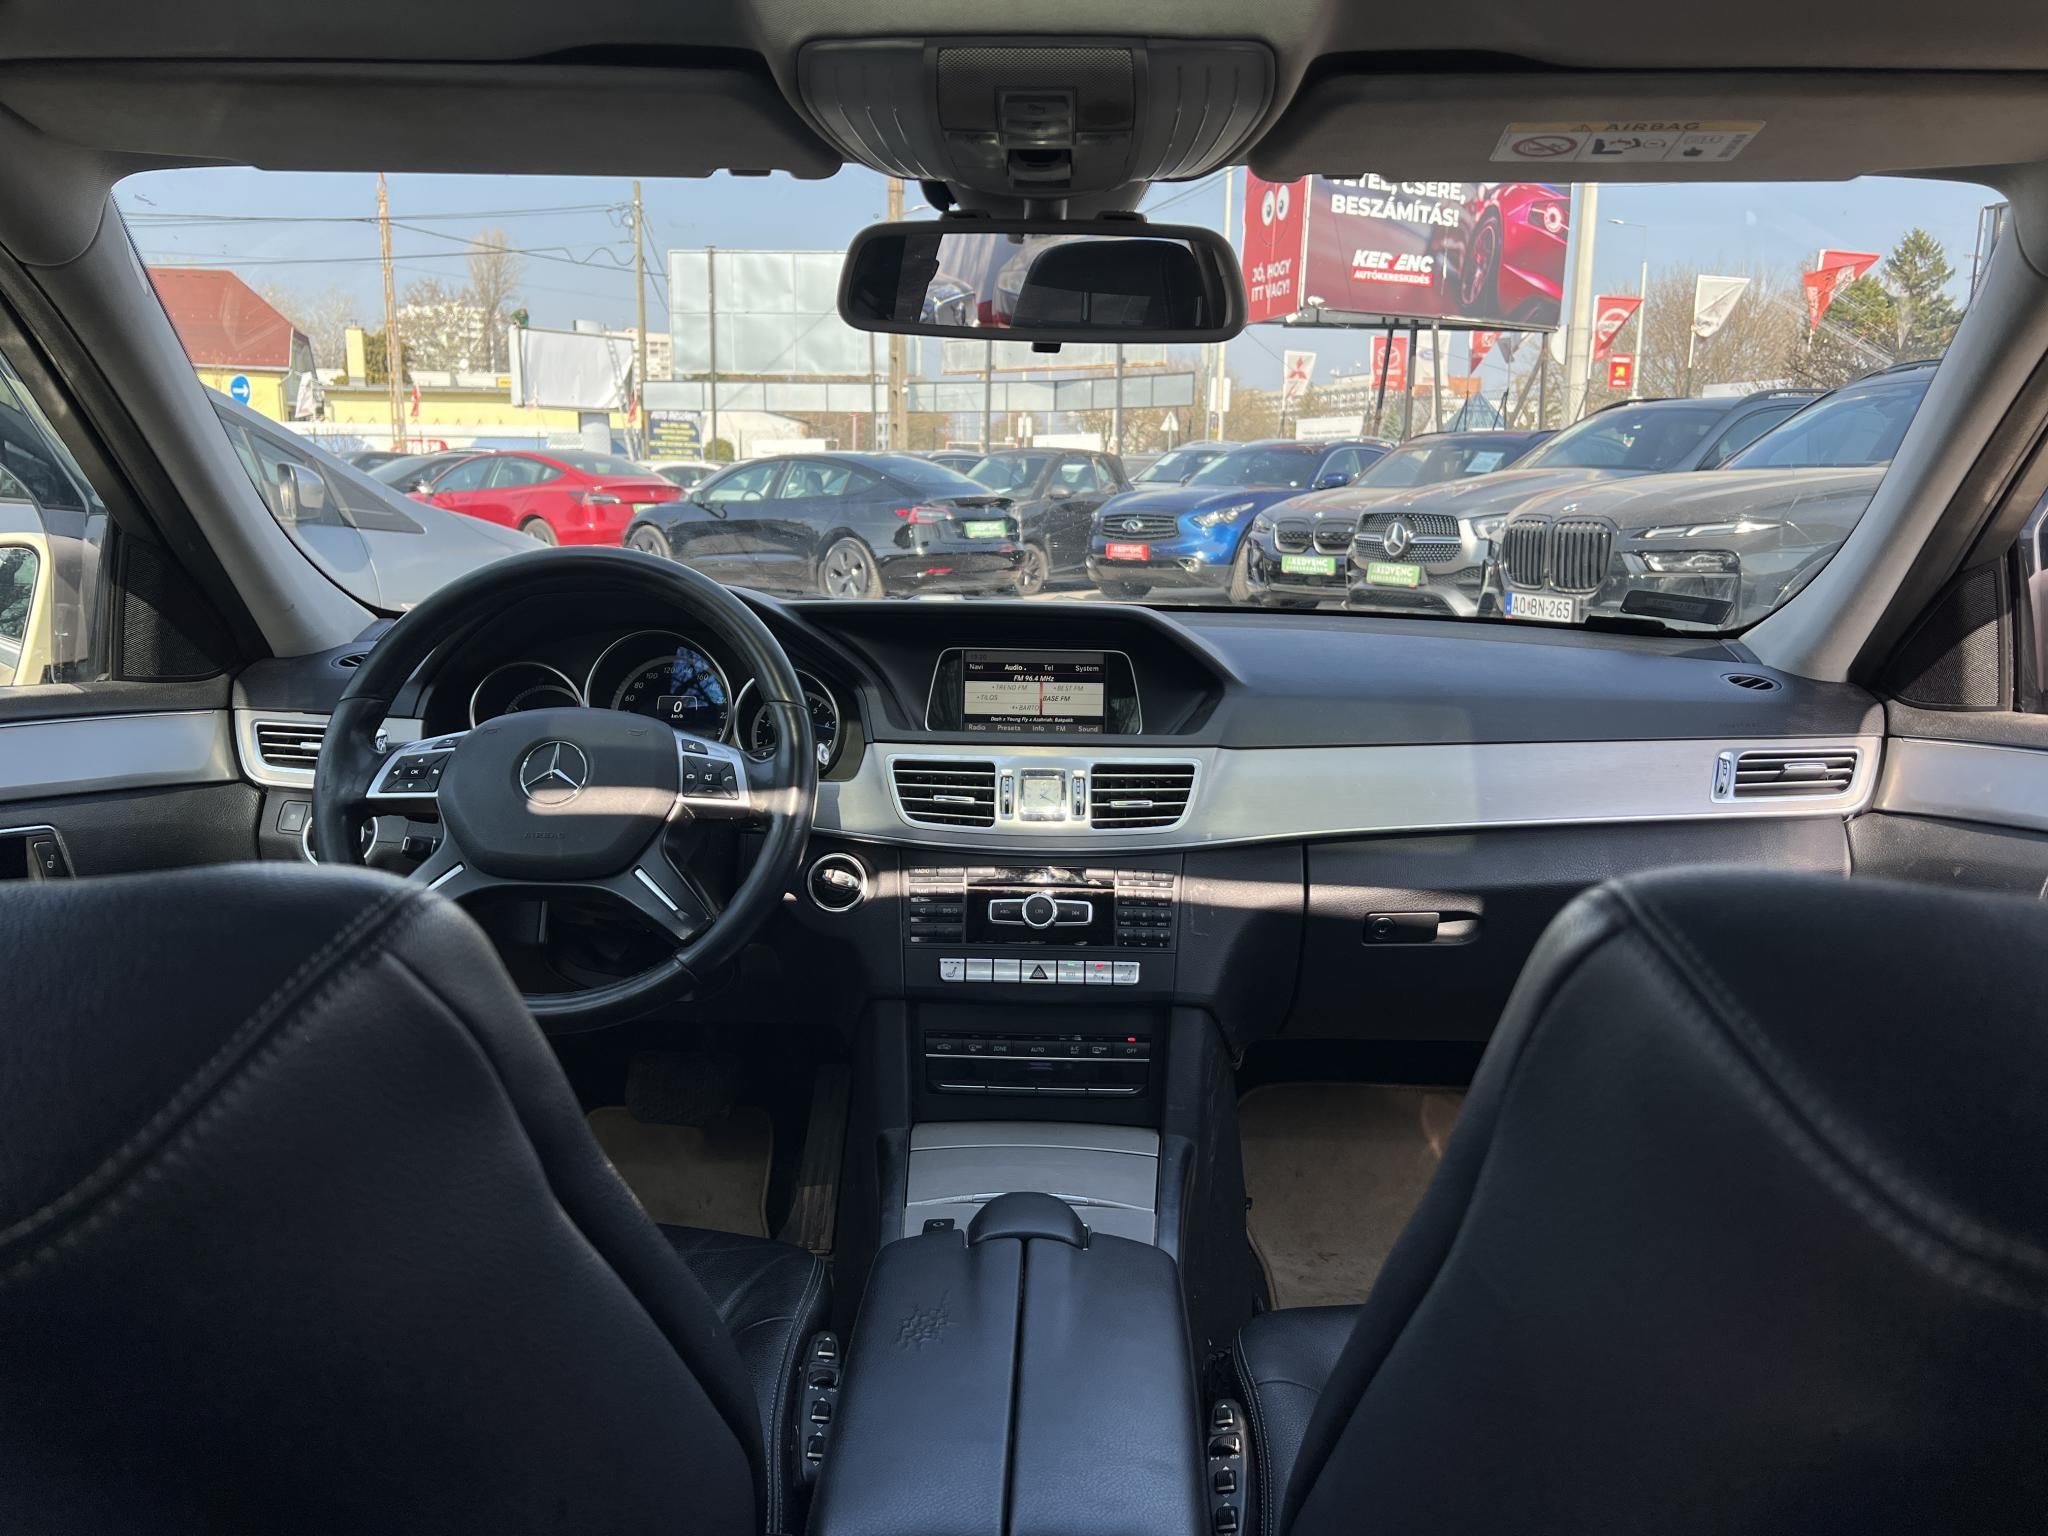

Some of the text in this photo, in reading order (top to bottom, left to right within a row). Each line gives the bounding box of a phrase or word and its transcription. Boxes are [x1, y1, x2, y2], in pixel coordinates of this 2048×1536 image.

[1605, 122, 1700, 131] AIRBAG
[1331, 195, 1459, 227] BESZÁMÍTÁS!
[673, 700, 683, 713] 0
